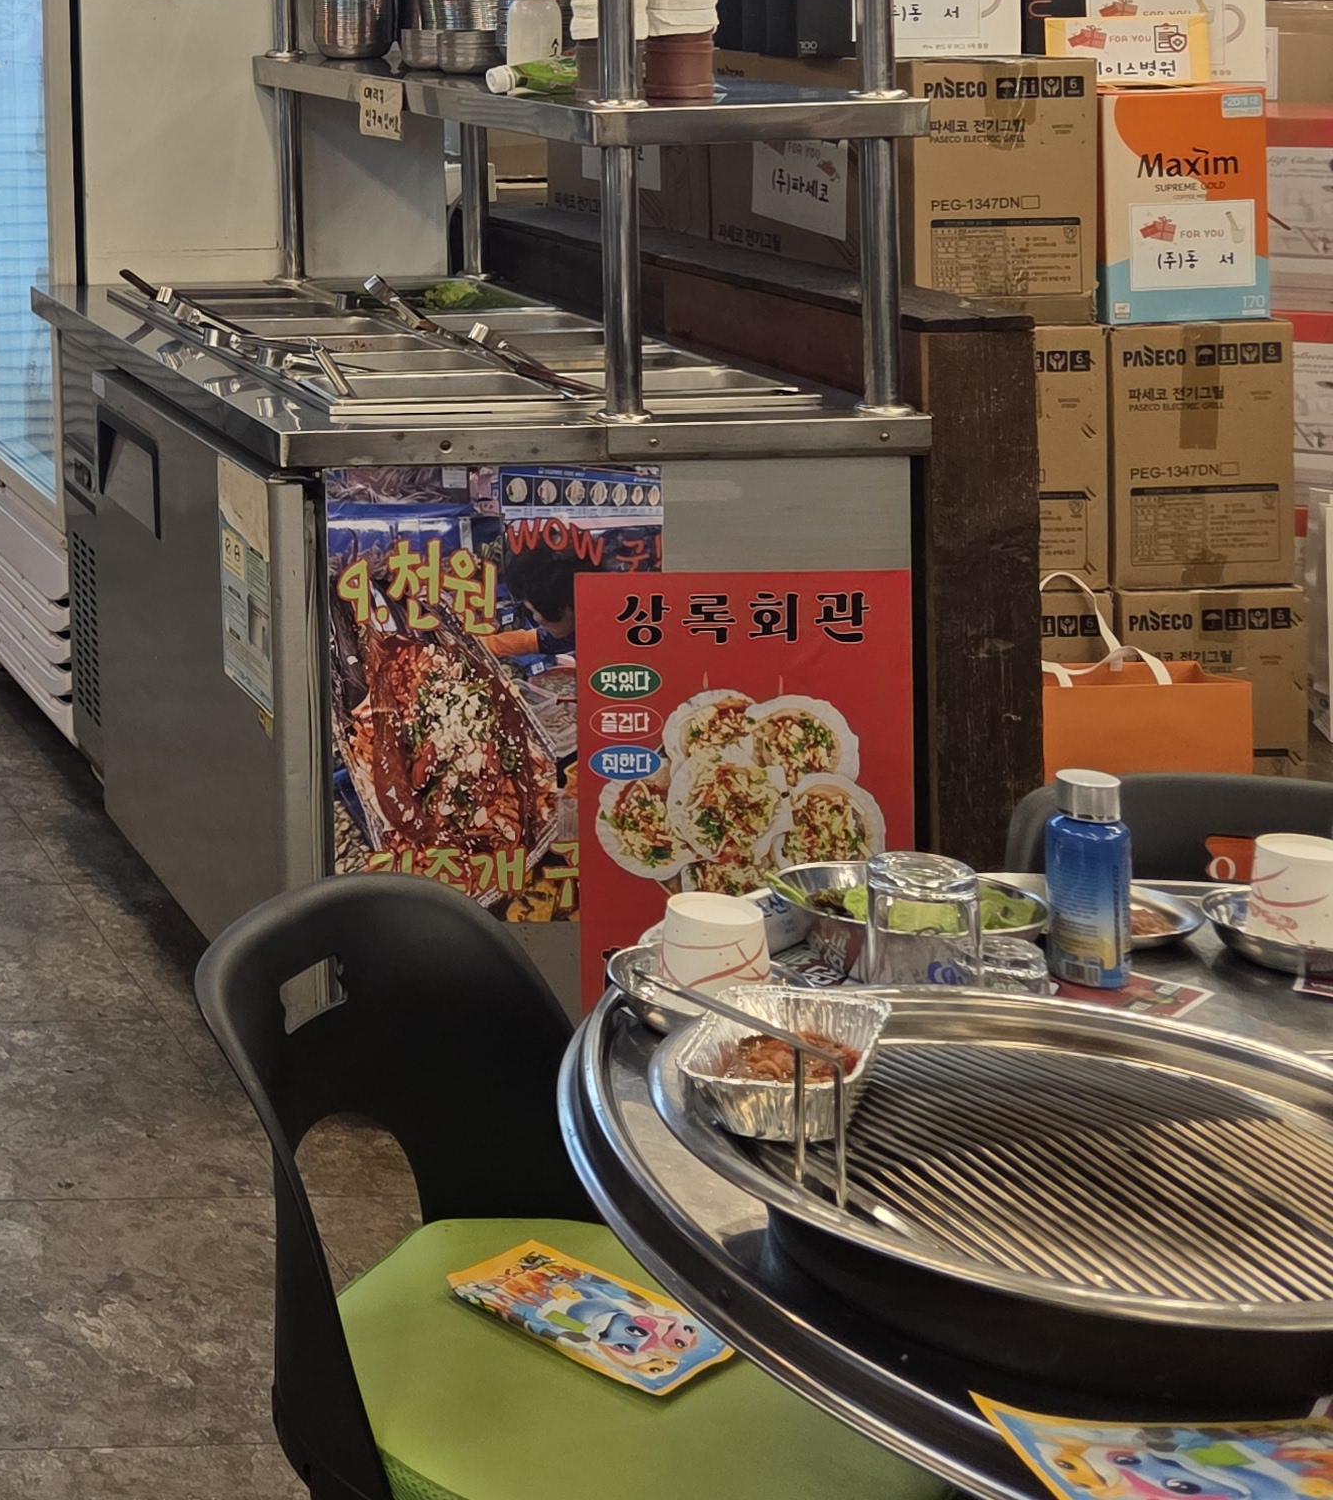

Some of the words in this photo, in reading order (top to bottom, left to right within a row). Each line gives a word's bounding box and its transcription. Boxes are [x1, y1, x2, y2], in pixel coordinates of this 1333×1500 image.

[1108, 35, 1129, 44] FOR
[1131, 34, 1152, 43] YOU
[924, 77, 988, 99] PASECO
[930, 120, 969, 134] 파세코
[973, 118, 1026, 133] 전기그릴
[1137, 147, 1240, 179] Maxim
[771, 167, 830, 203] (주)파세코
[1154, 182, 1197, 192] SUPREME
[1200, 180, 1226, 190] GOLD
[930, 196, 1020, 212] PEG-1347DN
[1179, 230, 1201, 239] FOR
[1203, 229, 1225, 238] YOU
[1242, 295, 1266, 308] 170
[1122, 345, 1187, 367] PASECO
[1128, 388, 1169, 402] 파세코
[1172, 386, 1225, 400] 전기그릴
[1130, 463, 1219, 480] PEG-1347DN
[507, 518, 604, 566] WOW
[615, 591, 871, 647] 상록회관
[1128, 609, 1193, 632] PASECO
[599, 669, 651, 693] 맛있다
[599, 711, 651, 735] 즐겁다
[600, 751, 653, 775] 취한다
